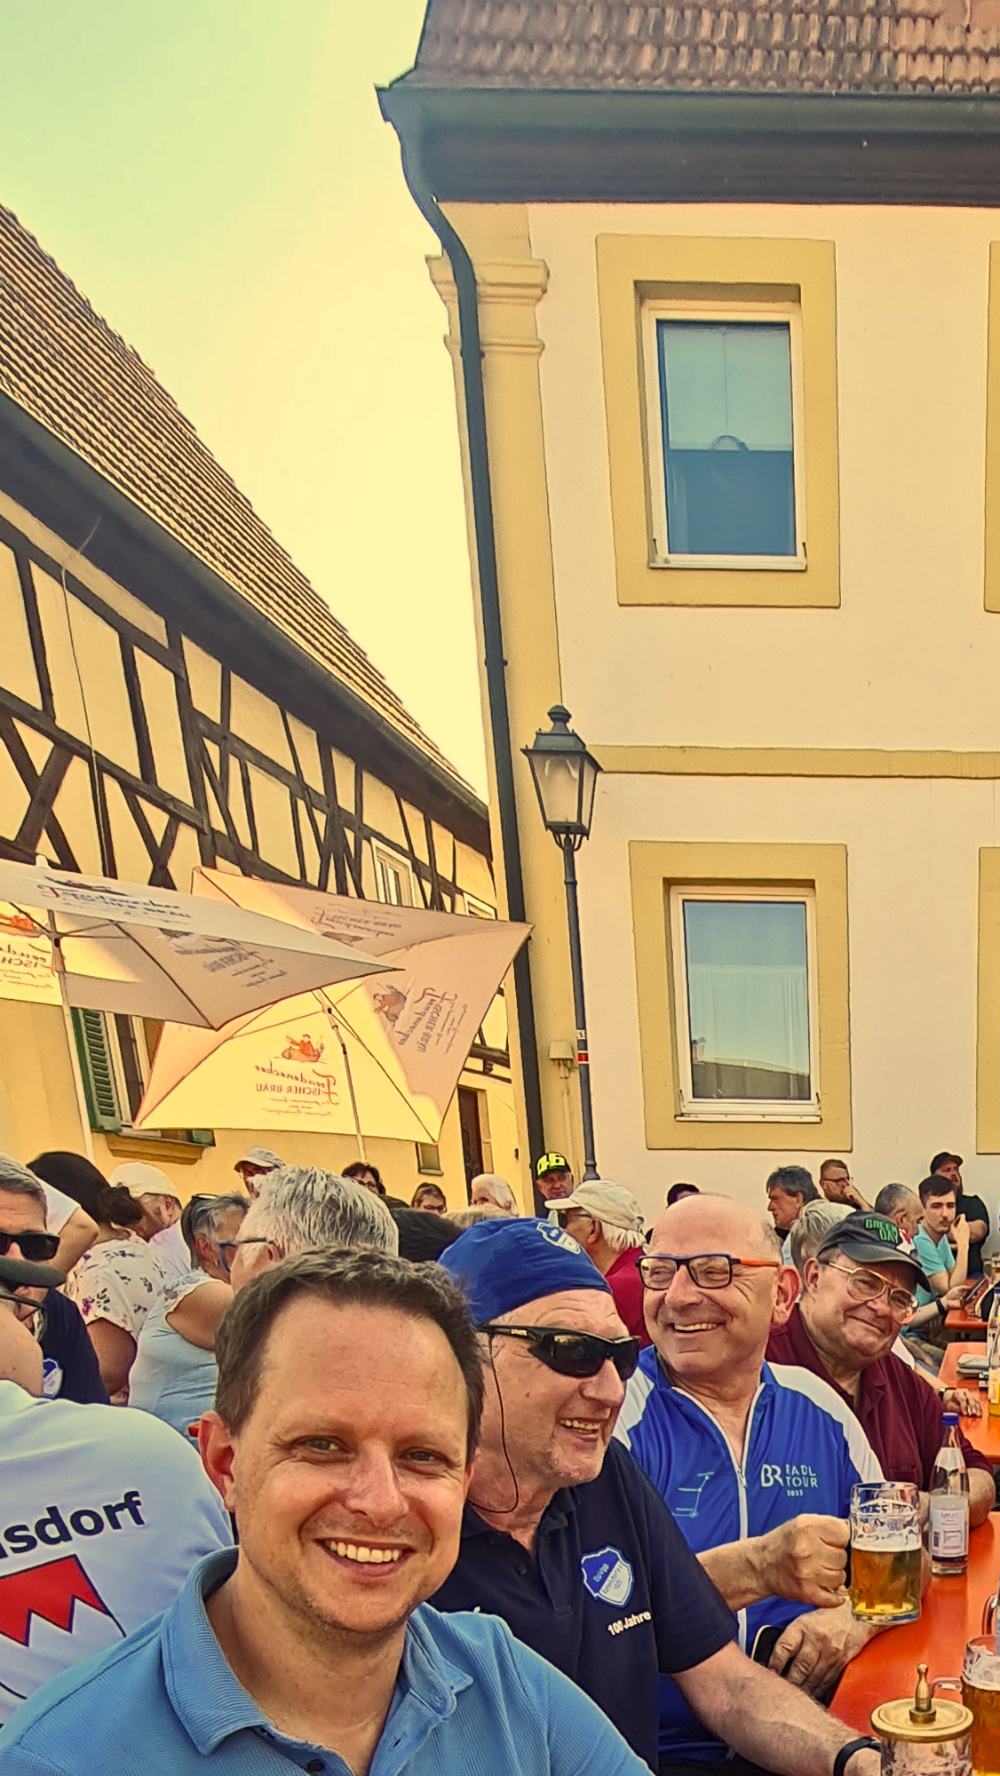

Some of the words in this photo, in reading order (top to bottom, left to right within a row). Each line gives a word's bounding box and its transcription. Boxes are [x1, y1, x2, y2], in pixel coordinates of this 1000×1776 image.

[865, 1218, 898, 1232] GREEN
[880, 1229, 899, 1244] DAY
[761, 1464, 785, 1487] BR
[786, 1476, 819, 1488] TOUR
[608, 1620, 624, 1636] 100
[623, 1611, 652, 1629] Jahre
